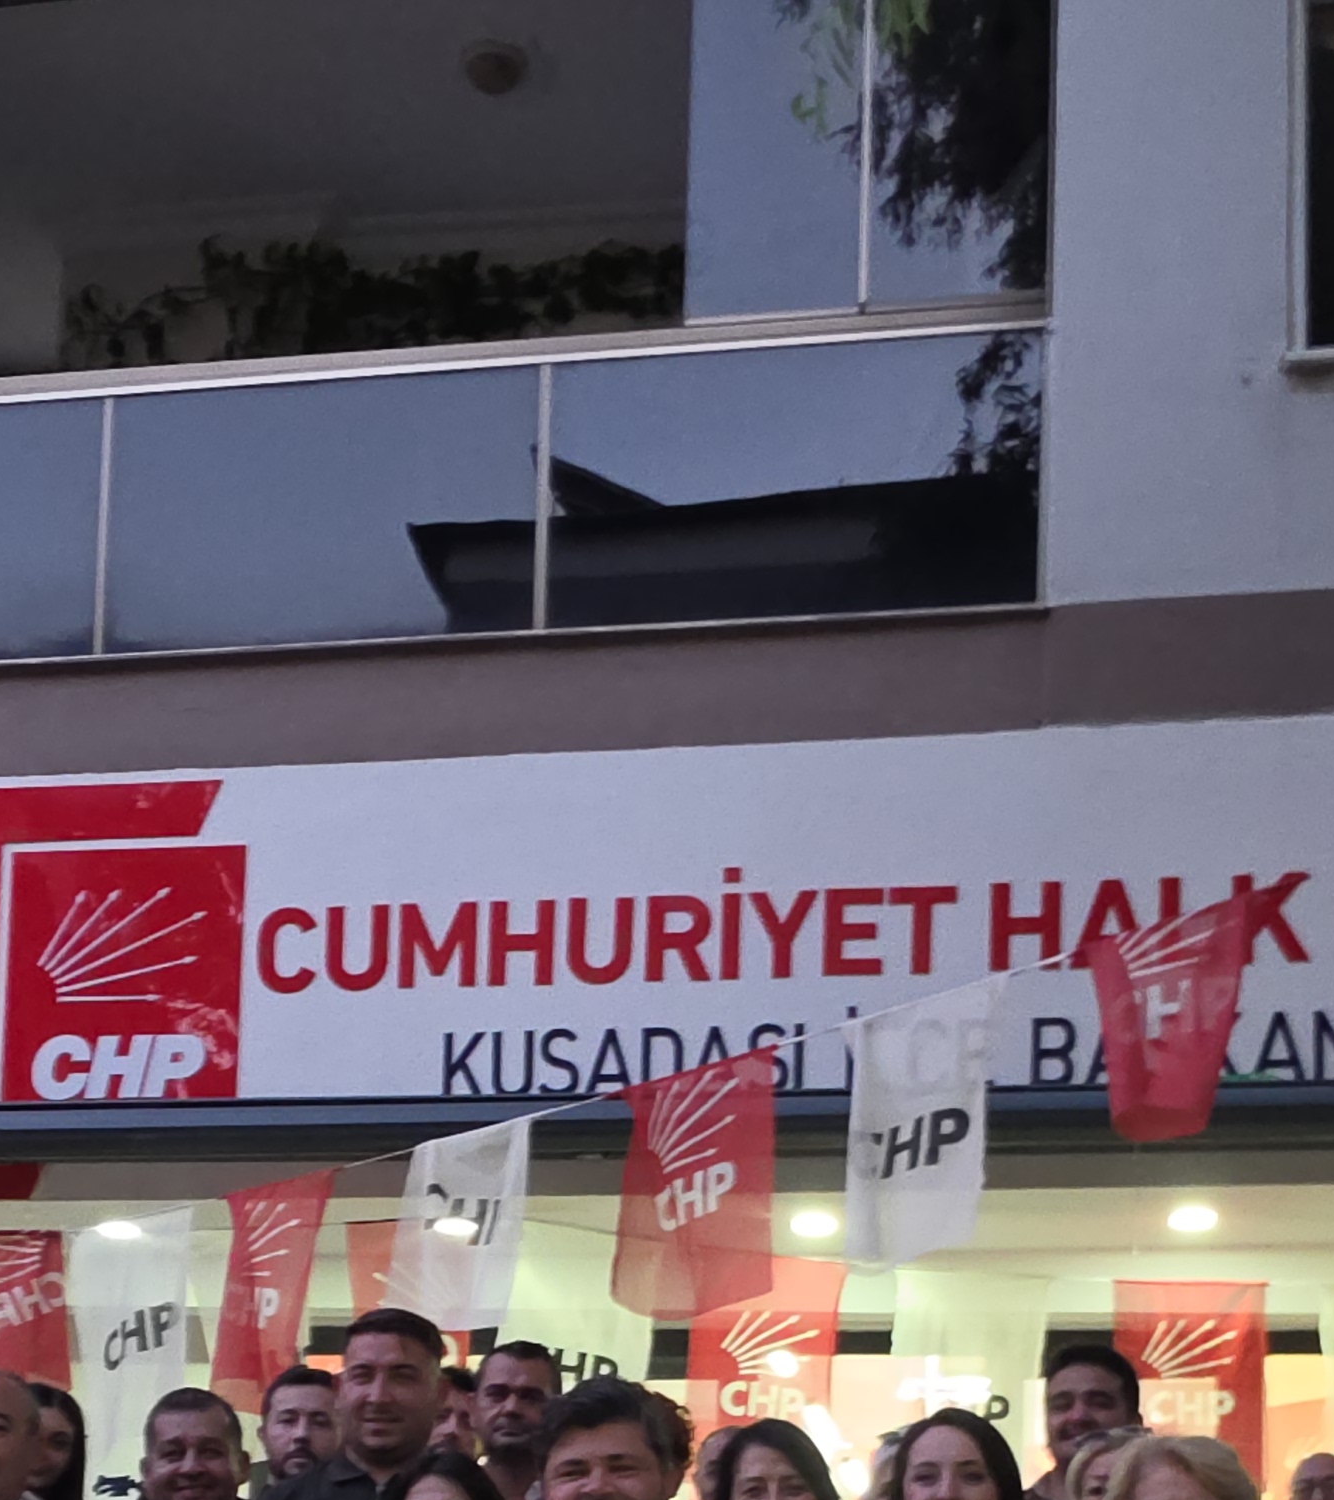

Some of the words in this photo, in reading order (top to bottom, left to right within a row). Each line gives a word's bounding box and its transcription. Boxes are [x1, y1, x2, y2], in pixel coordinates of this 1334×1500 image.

[256, 866, 957, 993] CUMHURİYET
[30, 1032, 206, 1100] CHP
[654, 1161, 736, 1232] CHP
[103, 1301, 180, 1371] CHP
[719, 1379, 807, 1418] CHP
[1147, 1389, 1237, 1425] CHP
